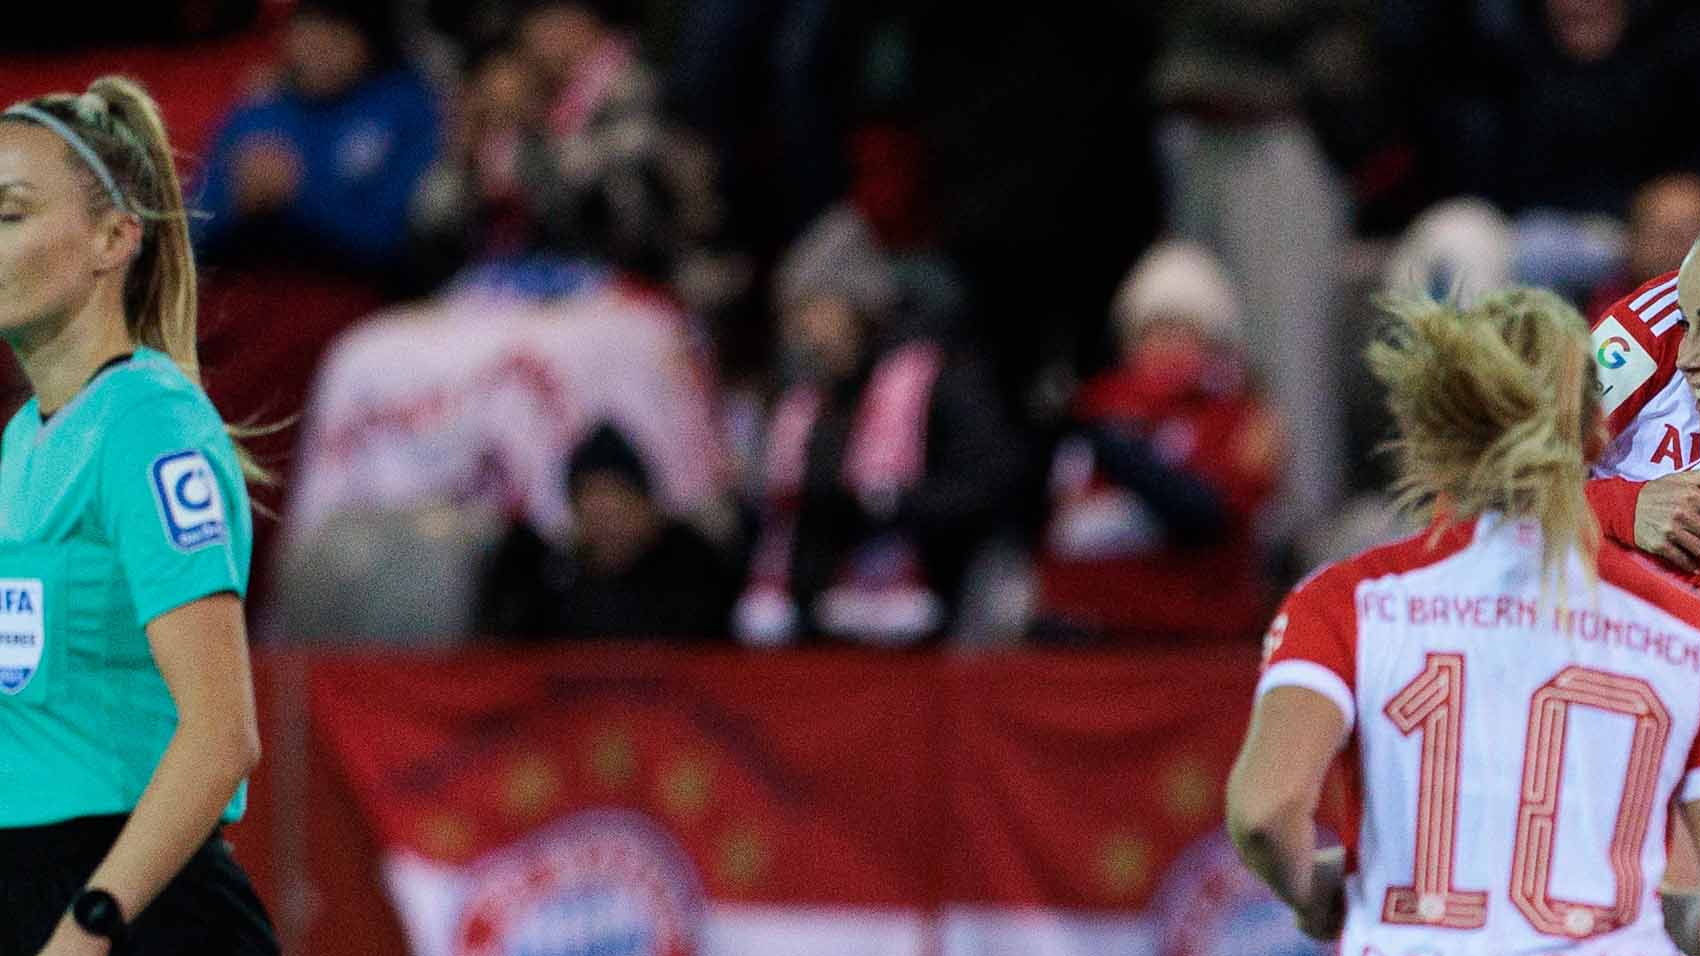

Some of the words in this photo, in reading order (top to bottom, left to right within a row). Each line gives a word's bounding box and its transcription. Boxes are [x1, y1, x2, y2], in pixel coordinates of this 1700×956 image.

[0, 588, 33, 613] FA
[1362, 591, 1397, 623] FC
[1408, 594, 1539, 629] BAYERN
[1382, 653, 1672, 941] 10
